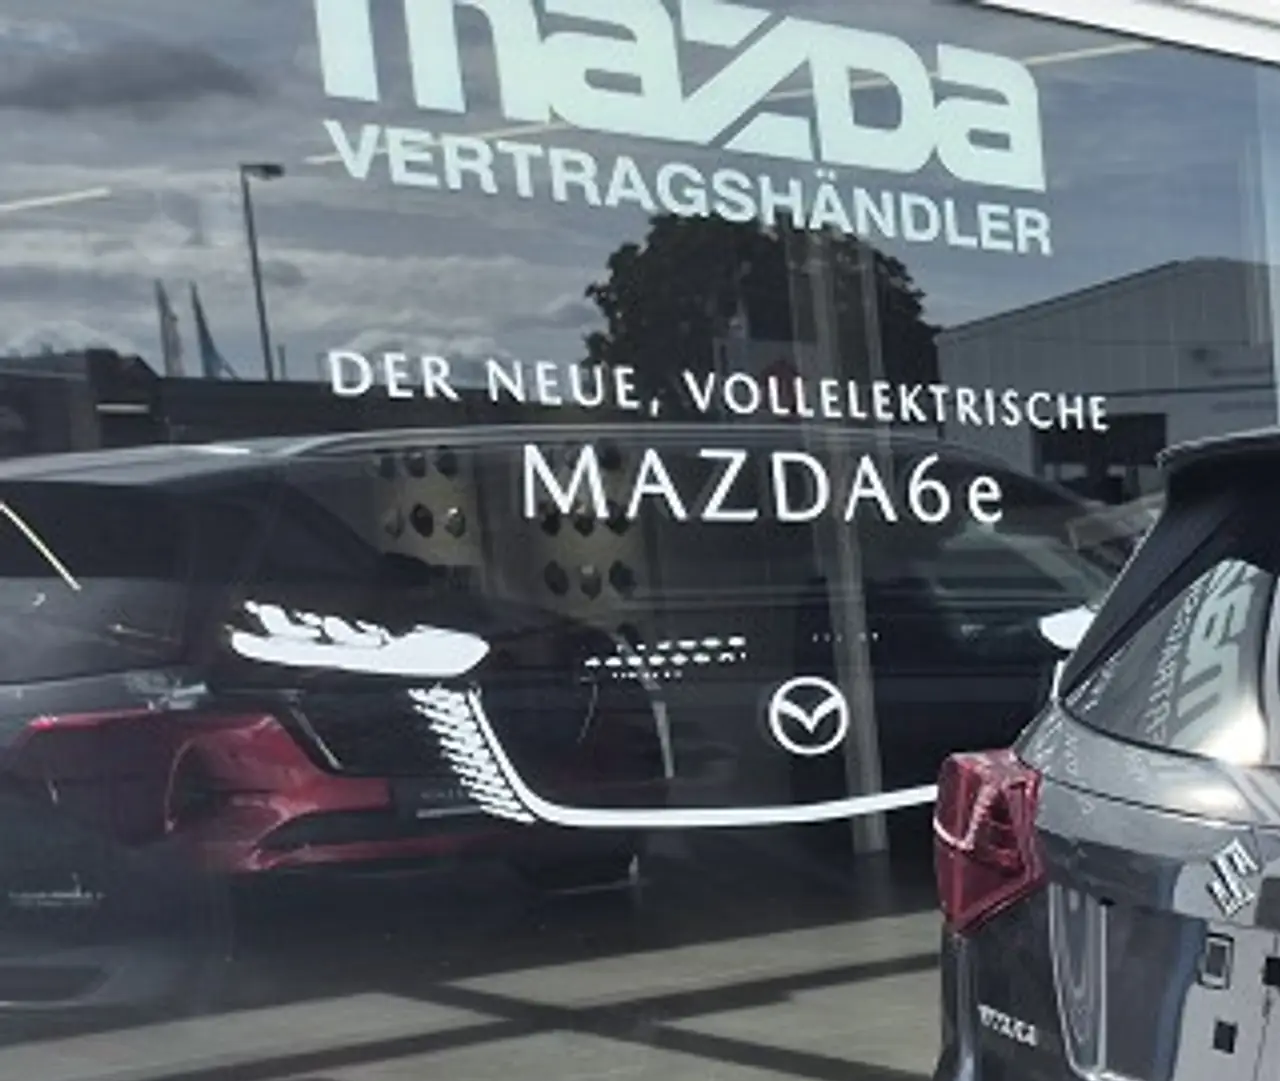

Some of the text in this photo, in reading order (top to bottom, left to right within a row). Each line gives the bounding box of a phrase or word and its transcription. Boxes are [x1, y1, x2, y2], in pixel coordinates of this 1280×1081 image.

[323, 120, 1052, 256] VERTRAGSHÄNDLER
[329, 352, 1110, 431] DER NEUE, VOLLELEKTRISCHE
[523, 444, 1003, 524] MAZDA6e
